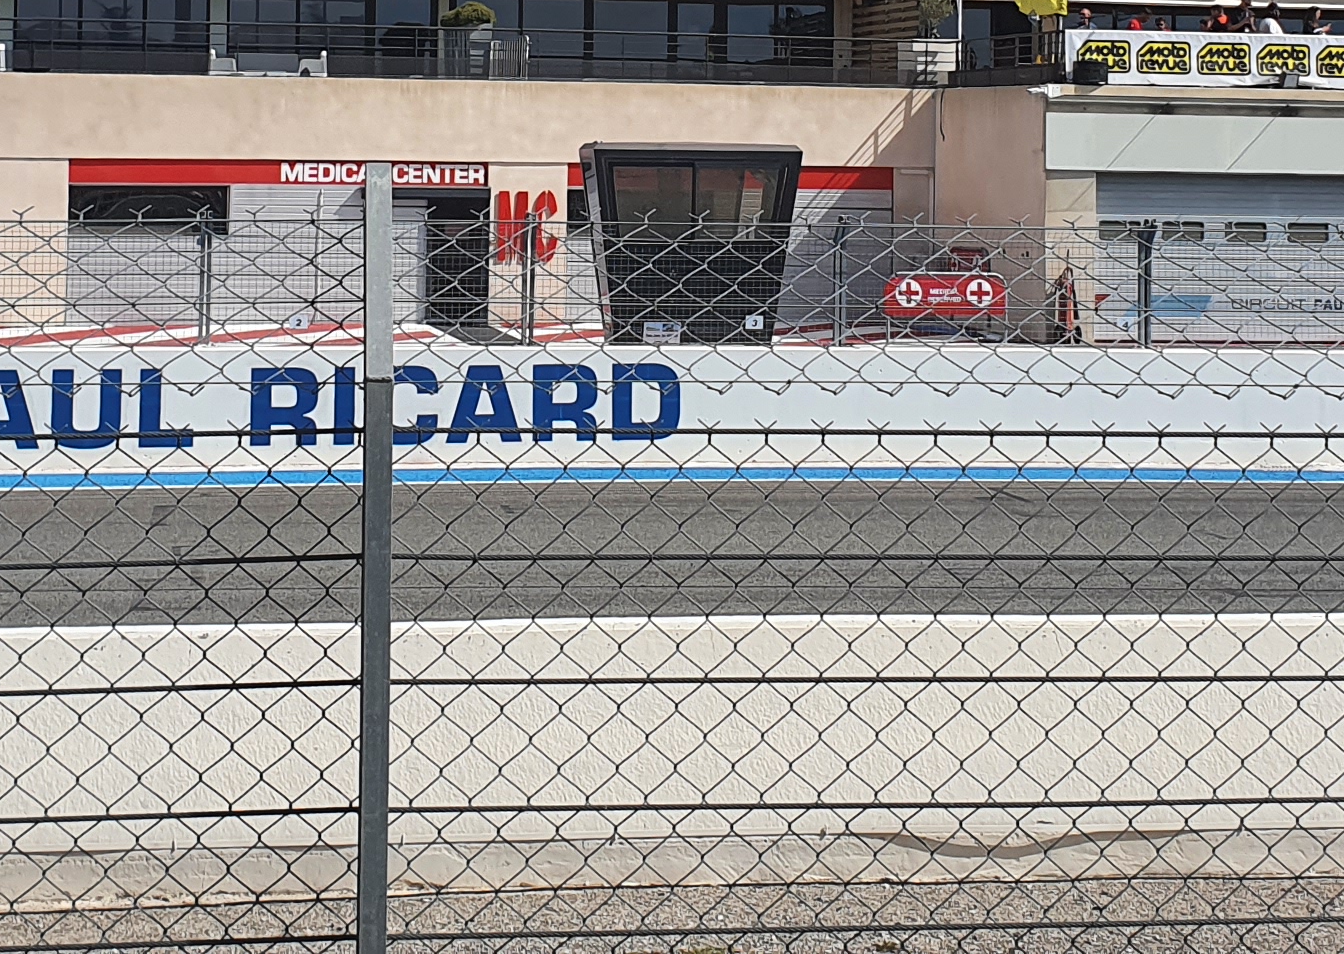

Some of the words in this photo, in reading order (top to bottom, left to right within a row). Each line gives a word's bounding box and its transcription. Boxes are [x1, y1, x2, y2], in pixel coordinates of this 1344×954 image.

[1080, 41, 1127, 58] Moto
[1139, 42, 1188, 58] Moto
[1200, 44, 1248, 59] Moto
[1259, 45, 1307, 60] Moto
[1140, 58, 1188, 71] revue
[1201, 59, 1249, 73] revue
[280, 162, 367, 183] MEDICA
[392, 163, 485, 184] CENTER
[495, 189, 558, 264] MC
[1231, 298, 1305, 310] CIRCUIT
[295, 318, 303, 327] 2
[249, 363, 682, 447] RICARD
